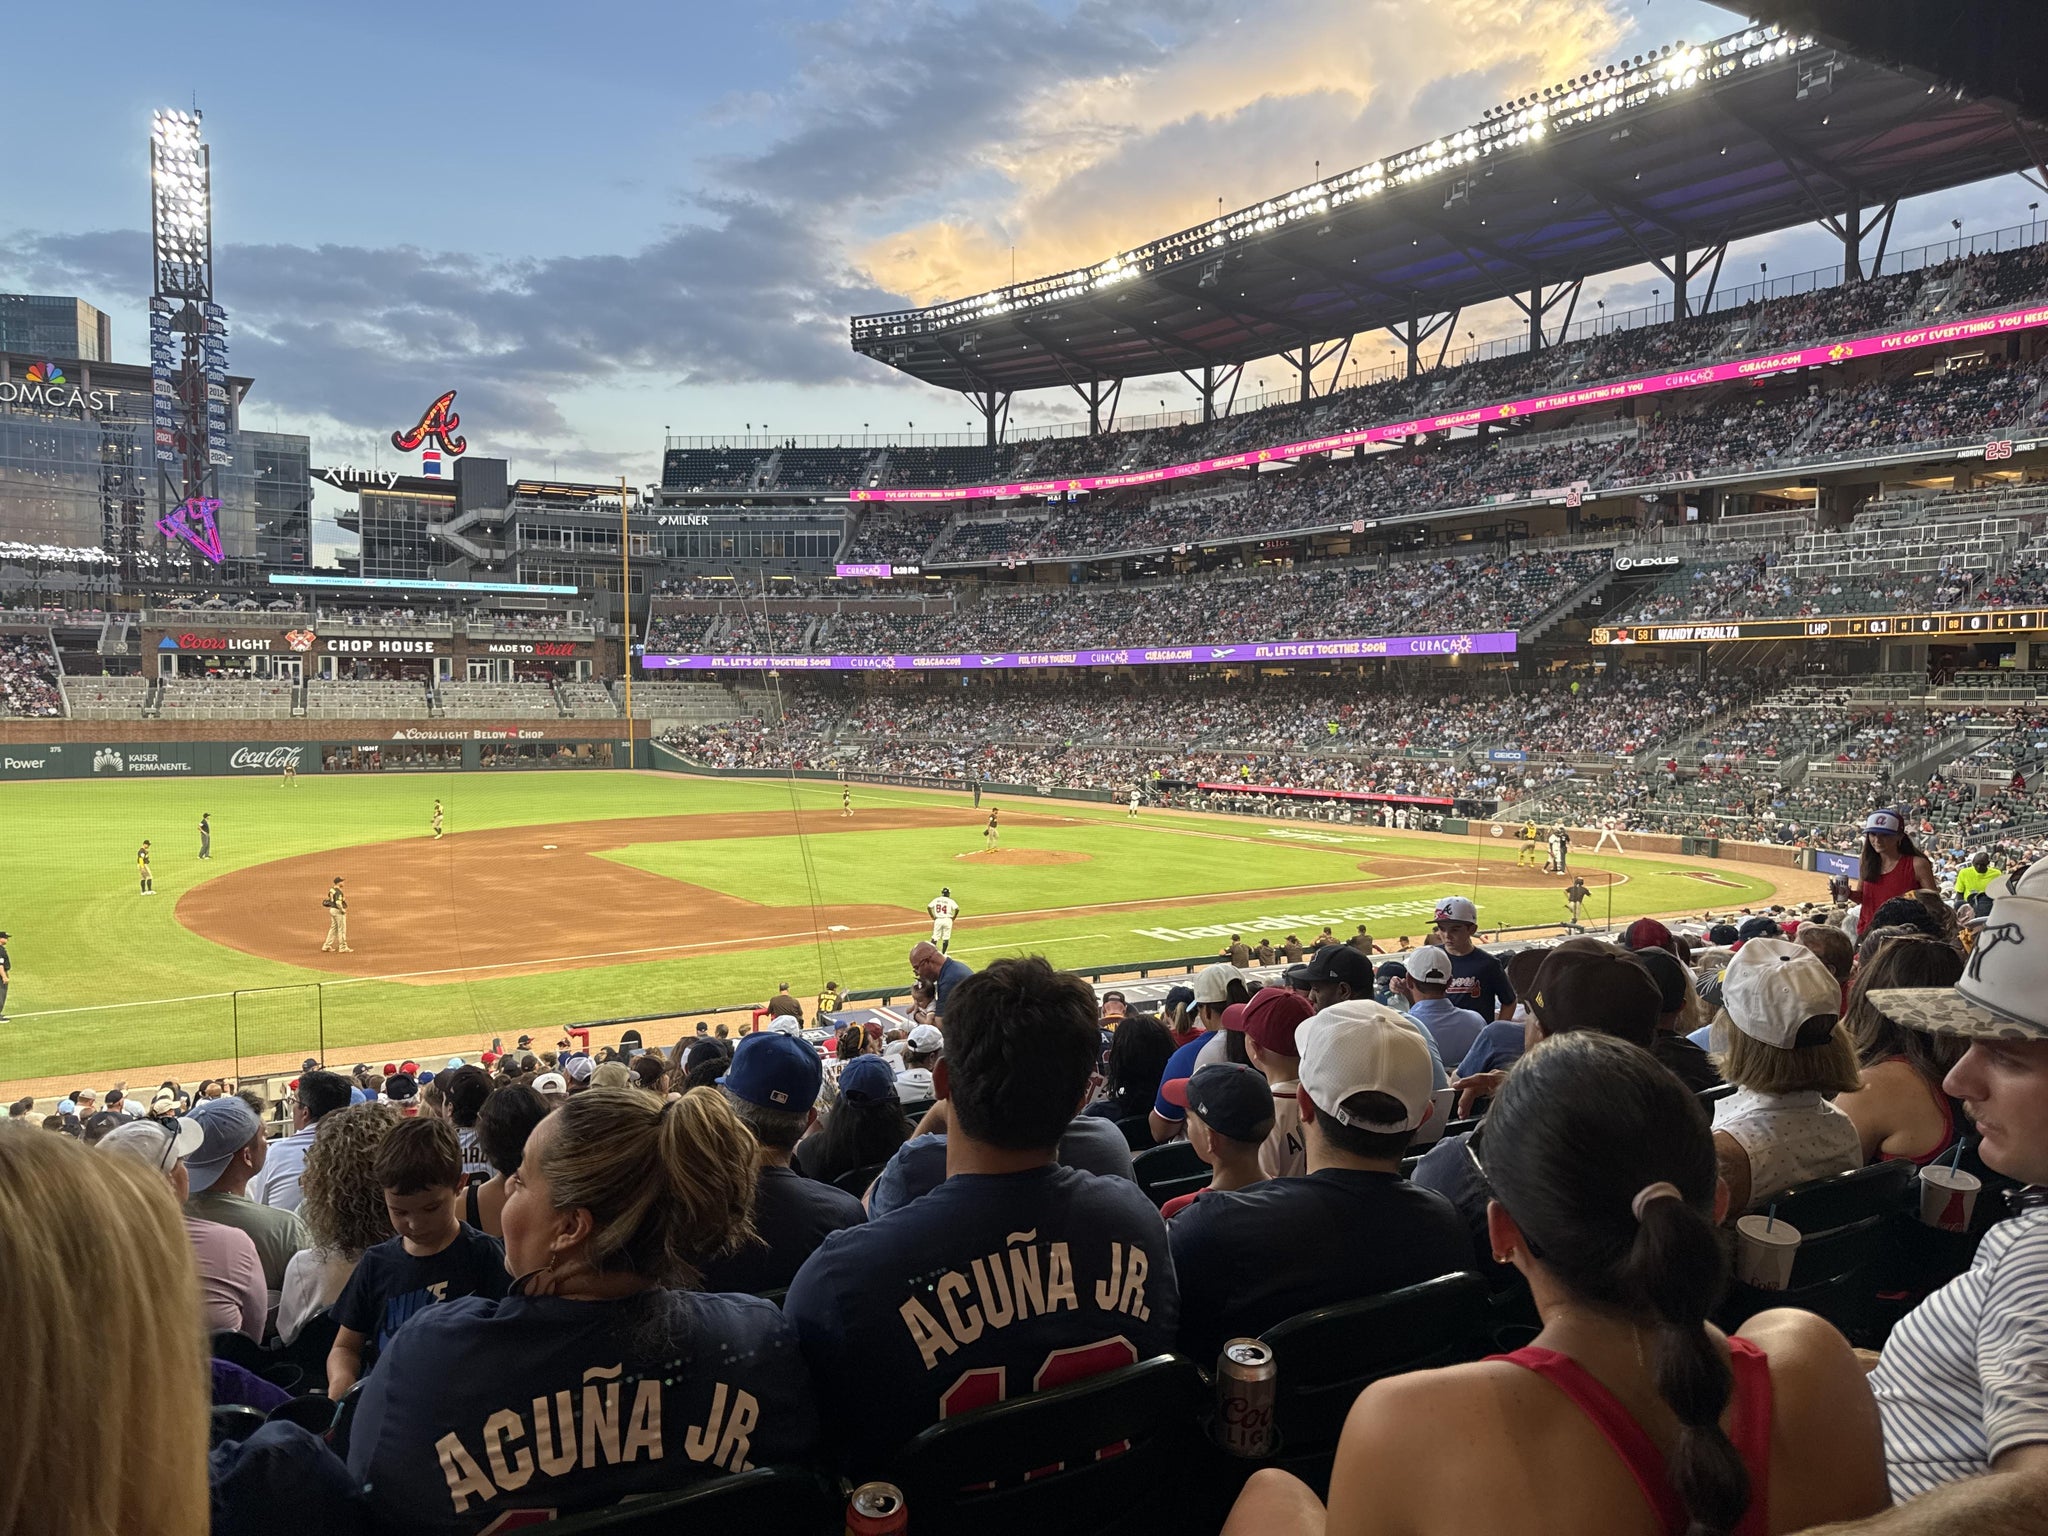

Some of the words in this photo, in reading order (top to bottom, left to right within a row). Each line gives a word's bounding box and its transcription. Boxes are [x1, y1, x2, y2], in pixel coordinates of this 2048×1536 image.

[207, 306, 222, 316] 1997
[1881, 338, 1901, 349] I'VE
[1903, 332, 1927, 345] GOT
[1928, 320, 1996, 340] EVERYTHING
[1998, 315, 2022, 328] YOU
[208, 339, 223, 349] 2001
[208, 371, 225, 381] 2005
[155, 382, 171, 393] 2010
[209, 387, 224, 398] 2012
[1536, 400, 1547, 409] MY
[1548, 396, 1569, 407] TEAM
[1569, 395, 1576, 403] IS
[1577, 389, 1610, 401] WAITING
[1611, 386, 1626, 396] FOR
[1627, 383, 1643, 393] YOU
[155, 400, 171, 410] 2013
[209, 404, 225, 414] 2018
[156, 416, 172, 426] 2019
[210, 420, 225, 430] 2020
[156, 433, 172, 445] 2021
[210, 436, 226, 447] 2022
[157, 450, 173, 461] 2023
[1985, 440, 2012, 460] 25
[2014, 442, 2036, 452] JONES
[211, 452, 227, 462] 2024
[323, 461, 399, 490] xfinity
[1566, 492, 1581, 507] 21
[668, 515, 709, 526] MILNER
[1632, 556, 1679, 566] LEXUS
[1853, 623, 1862, 632] IP
[1870, 620, 1887, 633] 0.1
[1901, 622, 1907, 631] H
[1922, 619, 1930, 631] 0
[1948, 620, 1959, 629] BB
[1970, 617, 1979, 629] 0
[1997, 617, 2004, 627] K
[2020, 615, 2027, 627] 1
[1638, 629, 1648, 640] 58
[1657, 626, 1693, 641] WANDY
[1694, 625, 1740, 639] PERALTA
[1809, 623, 1828, 635] LHP
[179, 633, 227, 650] Coors
[228, 639, 271, 650] LIGHT
[327, 640, 373, 652] CHOP
[380, 641, 434, 653] HOUSE
[489, 644, 518, 653] MADE
[520, 645, 533, 653] TO
[536, 642, 576, 656] Chill
[1275, 645, 1297, 656] LET'S
[1298, 645, 1314, 656] GET
[1316, 643, 1360, 655] TOGETHER
[1361, 642, 1386, 653] SOON
[769, 658, 808, 667] TOGETHER
[406, 728, 439, 740] Coors
[439, 731, 469, 739] LIGHT
[518, 730, 544, 739] CHOP
[5, 757, 45, 769] Power
[129, 754, 158, 762] KAISER
[230, 746, 304, 768] Coca-Cola
[129, 763, 188, 771] PERMANENTE
[936, 904, 947, 914] 84
[899, 1228, 1078, 1371] ACUÑA
[1096, 1242, 1151, 1323] JR.
[434, 1363, 664, 1513] ACUÑA
[684, 1382, 760, 1474] JR.
